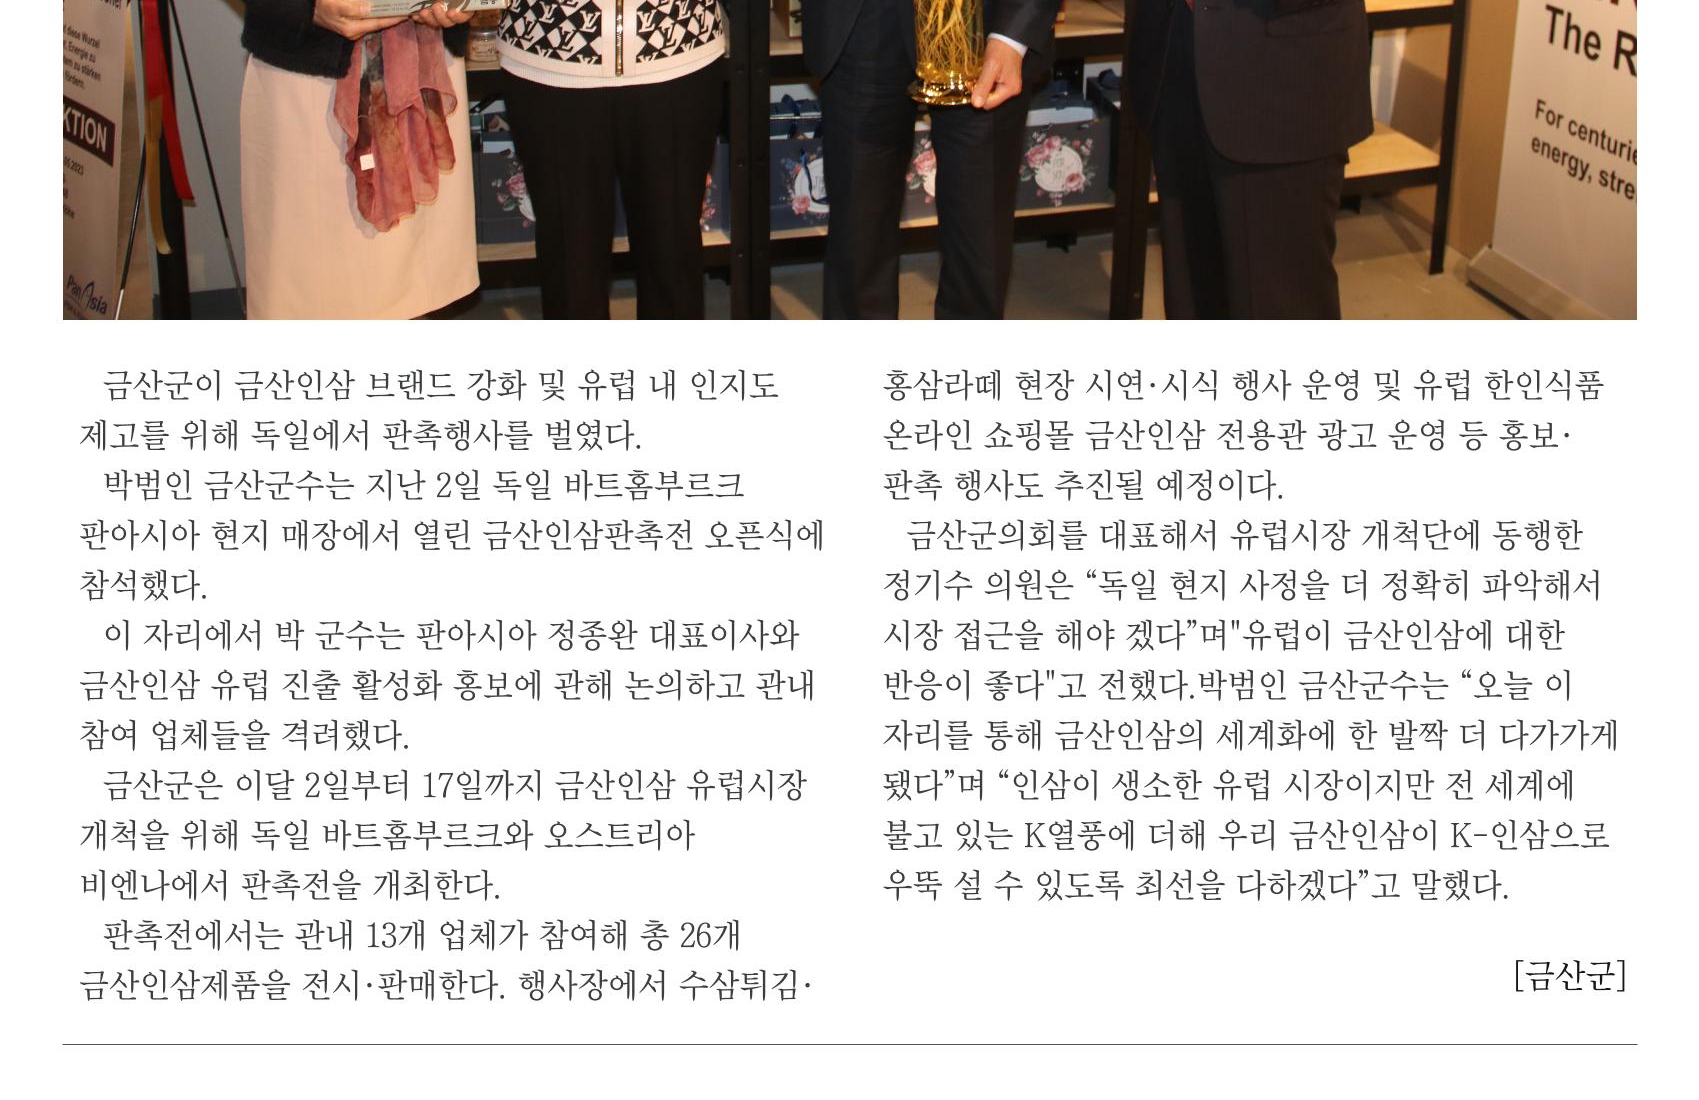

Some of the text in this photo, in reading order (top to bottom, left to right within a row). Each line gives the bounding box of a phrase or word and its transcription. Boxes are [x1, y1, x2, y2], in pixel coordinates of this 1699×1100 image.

[1545, 4, 1601, 61] The
[1535, 99, 1564, 129] For
[1531, 136, 1592, 184] energy,
[104, 370, 778, 401] 금산군이 금산인삼 브랜드 강화 및 유럽 내 인지도
[884, 369, 1604, 401] 홍삼라떼 현장 시연·시식 행사 운영 및 유럽 한인식품
[104, 469, 744, 501] 박범인 금산군수는 지난 2일 독일 바트홈부르크
[907, 519, 1583, 551] 금산군의회를 대표해서 유럽시장 개척단에 동행한
[81, 570, 206, 601] 참석했다.
[884, 569, 1598, 601] 정기수 의원은 “독일 현지 사정을 더 정확히 파악해서
[106, 620, 799, 651] 이 자리에서 박 군수는 판아시아 정종완 대표이사와
[884, 669, 1569, 701] 반응이 좋다"고 전했다.박범인 금산군수는 “오늘 이
[81, 719, 408, 751] 참여 업체들을 격려했다.
[104, 769, 807, 801] 금산군은 이달 2일부터 17일까지 금산인삼 유럽시장
[883, 769, 1572, 801] 됐다”며 “인삼이 생소한 유럽 시장이지만 전 세계에
[883, 820, 1609, 851] 불고 있는 K열풍에 더해 우리 금산인삼이 K-인삼으로
[81, 869, 499, 901] 비엔나에서 판촉전을 개최한다.
[884, 869, 1507, 901] 우뚝 설 수 있도록 최선을 다하겠다”고 말했다.
[104, 919, 738, 951] 판촉전에서는 관내 13개 업체가 참여해 총 26개
[80, 969, 810, 1001] 금산인삼제품을 전시·판매한다. 행사장에서 수삼튀김·
[1516, 960, 1625, 992] [금산군]
